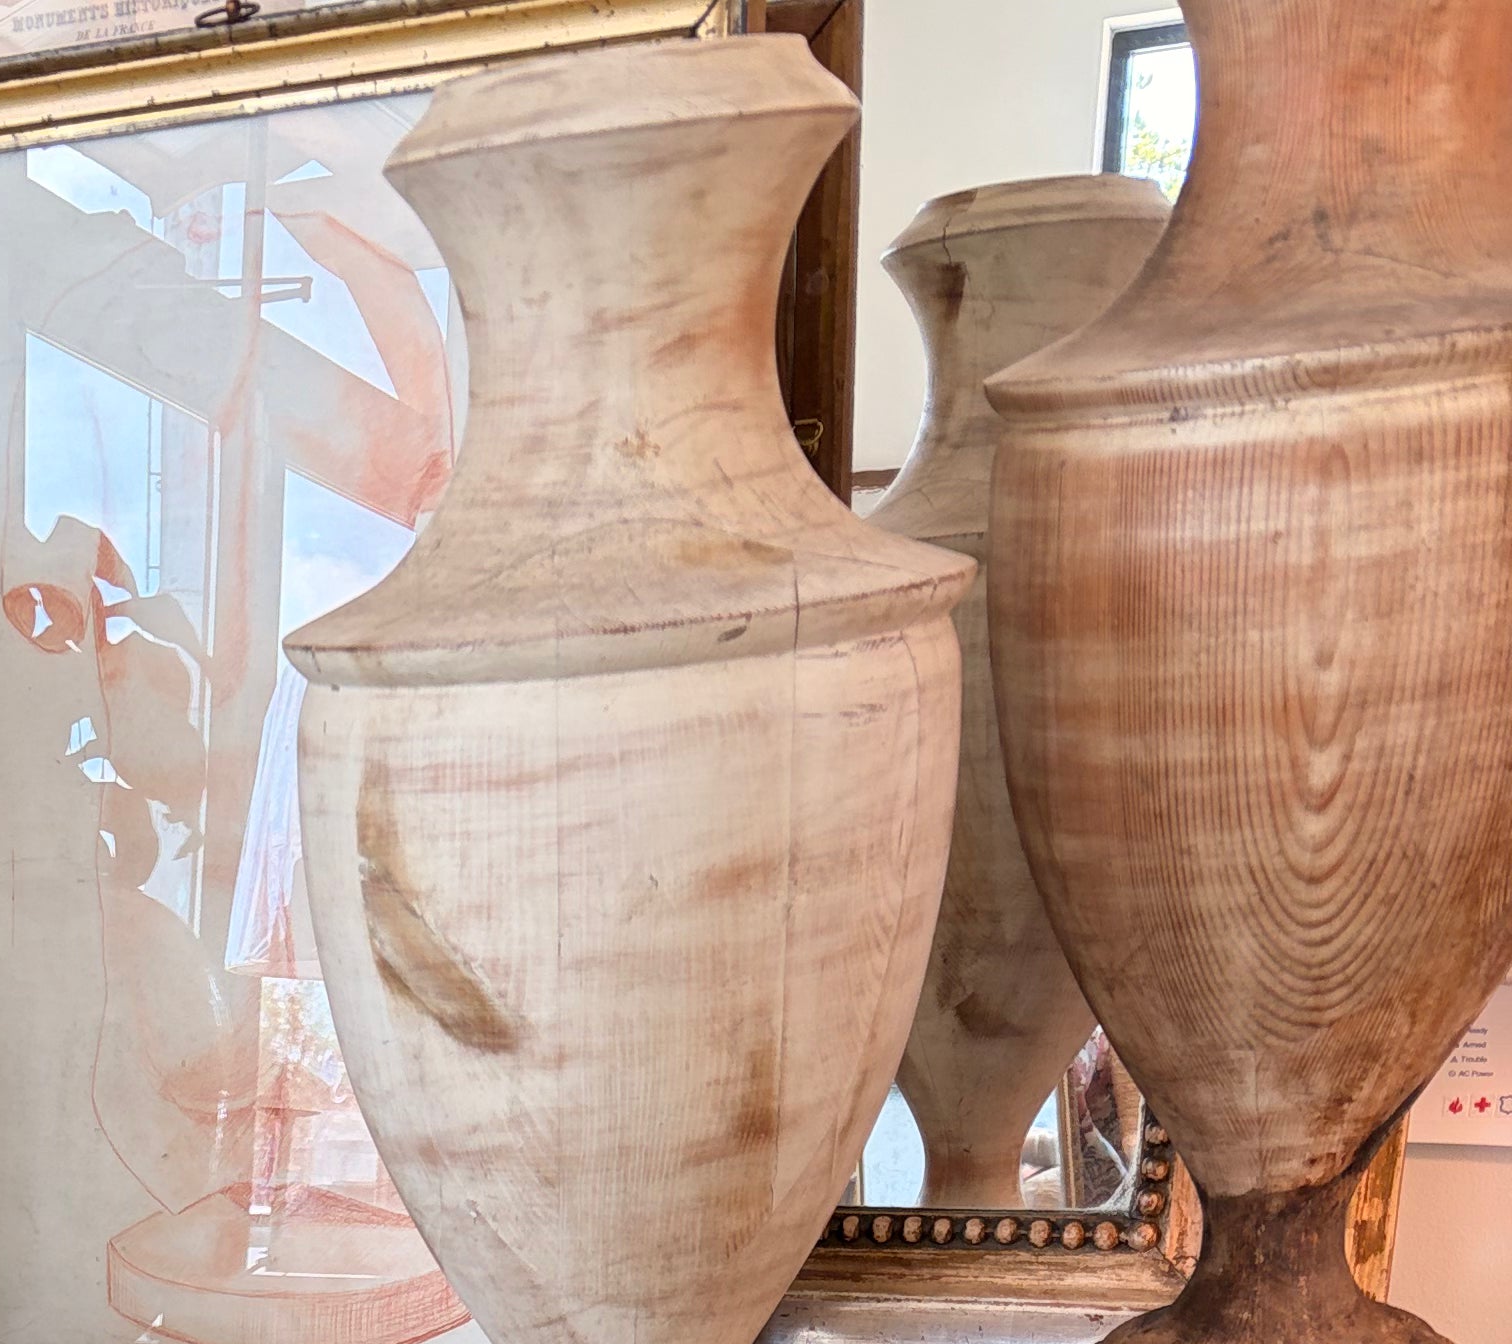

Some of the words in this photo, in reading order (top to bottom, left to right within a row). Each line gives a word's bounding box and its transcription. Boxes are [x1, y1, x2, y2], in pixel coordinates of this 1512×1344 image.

[12, 4, 109, 32] MONUMENTS
[76, 29, 90, 40] DE
[96, 27, 109, 38] LA
[112, 20, 155, 36] FRANCE
[1468, 1027, 1488, 1035] eady
